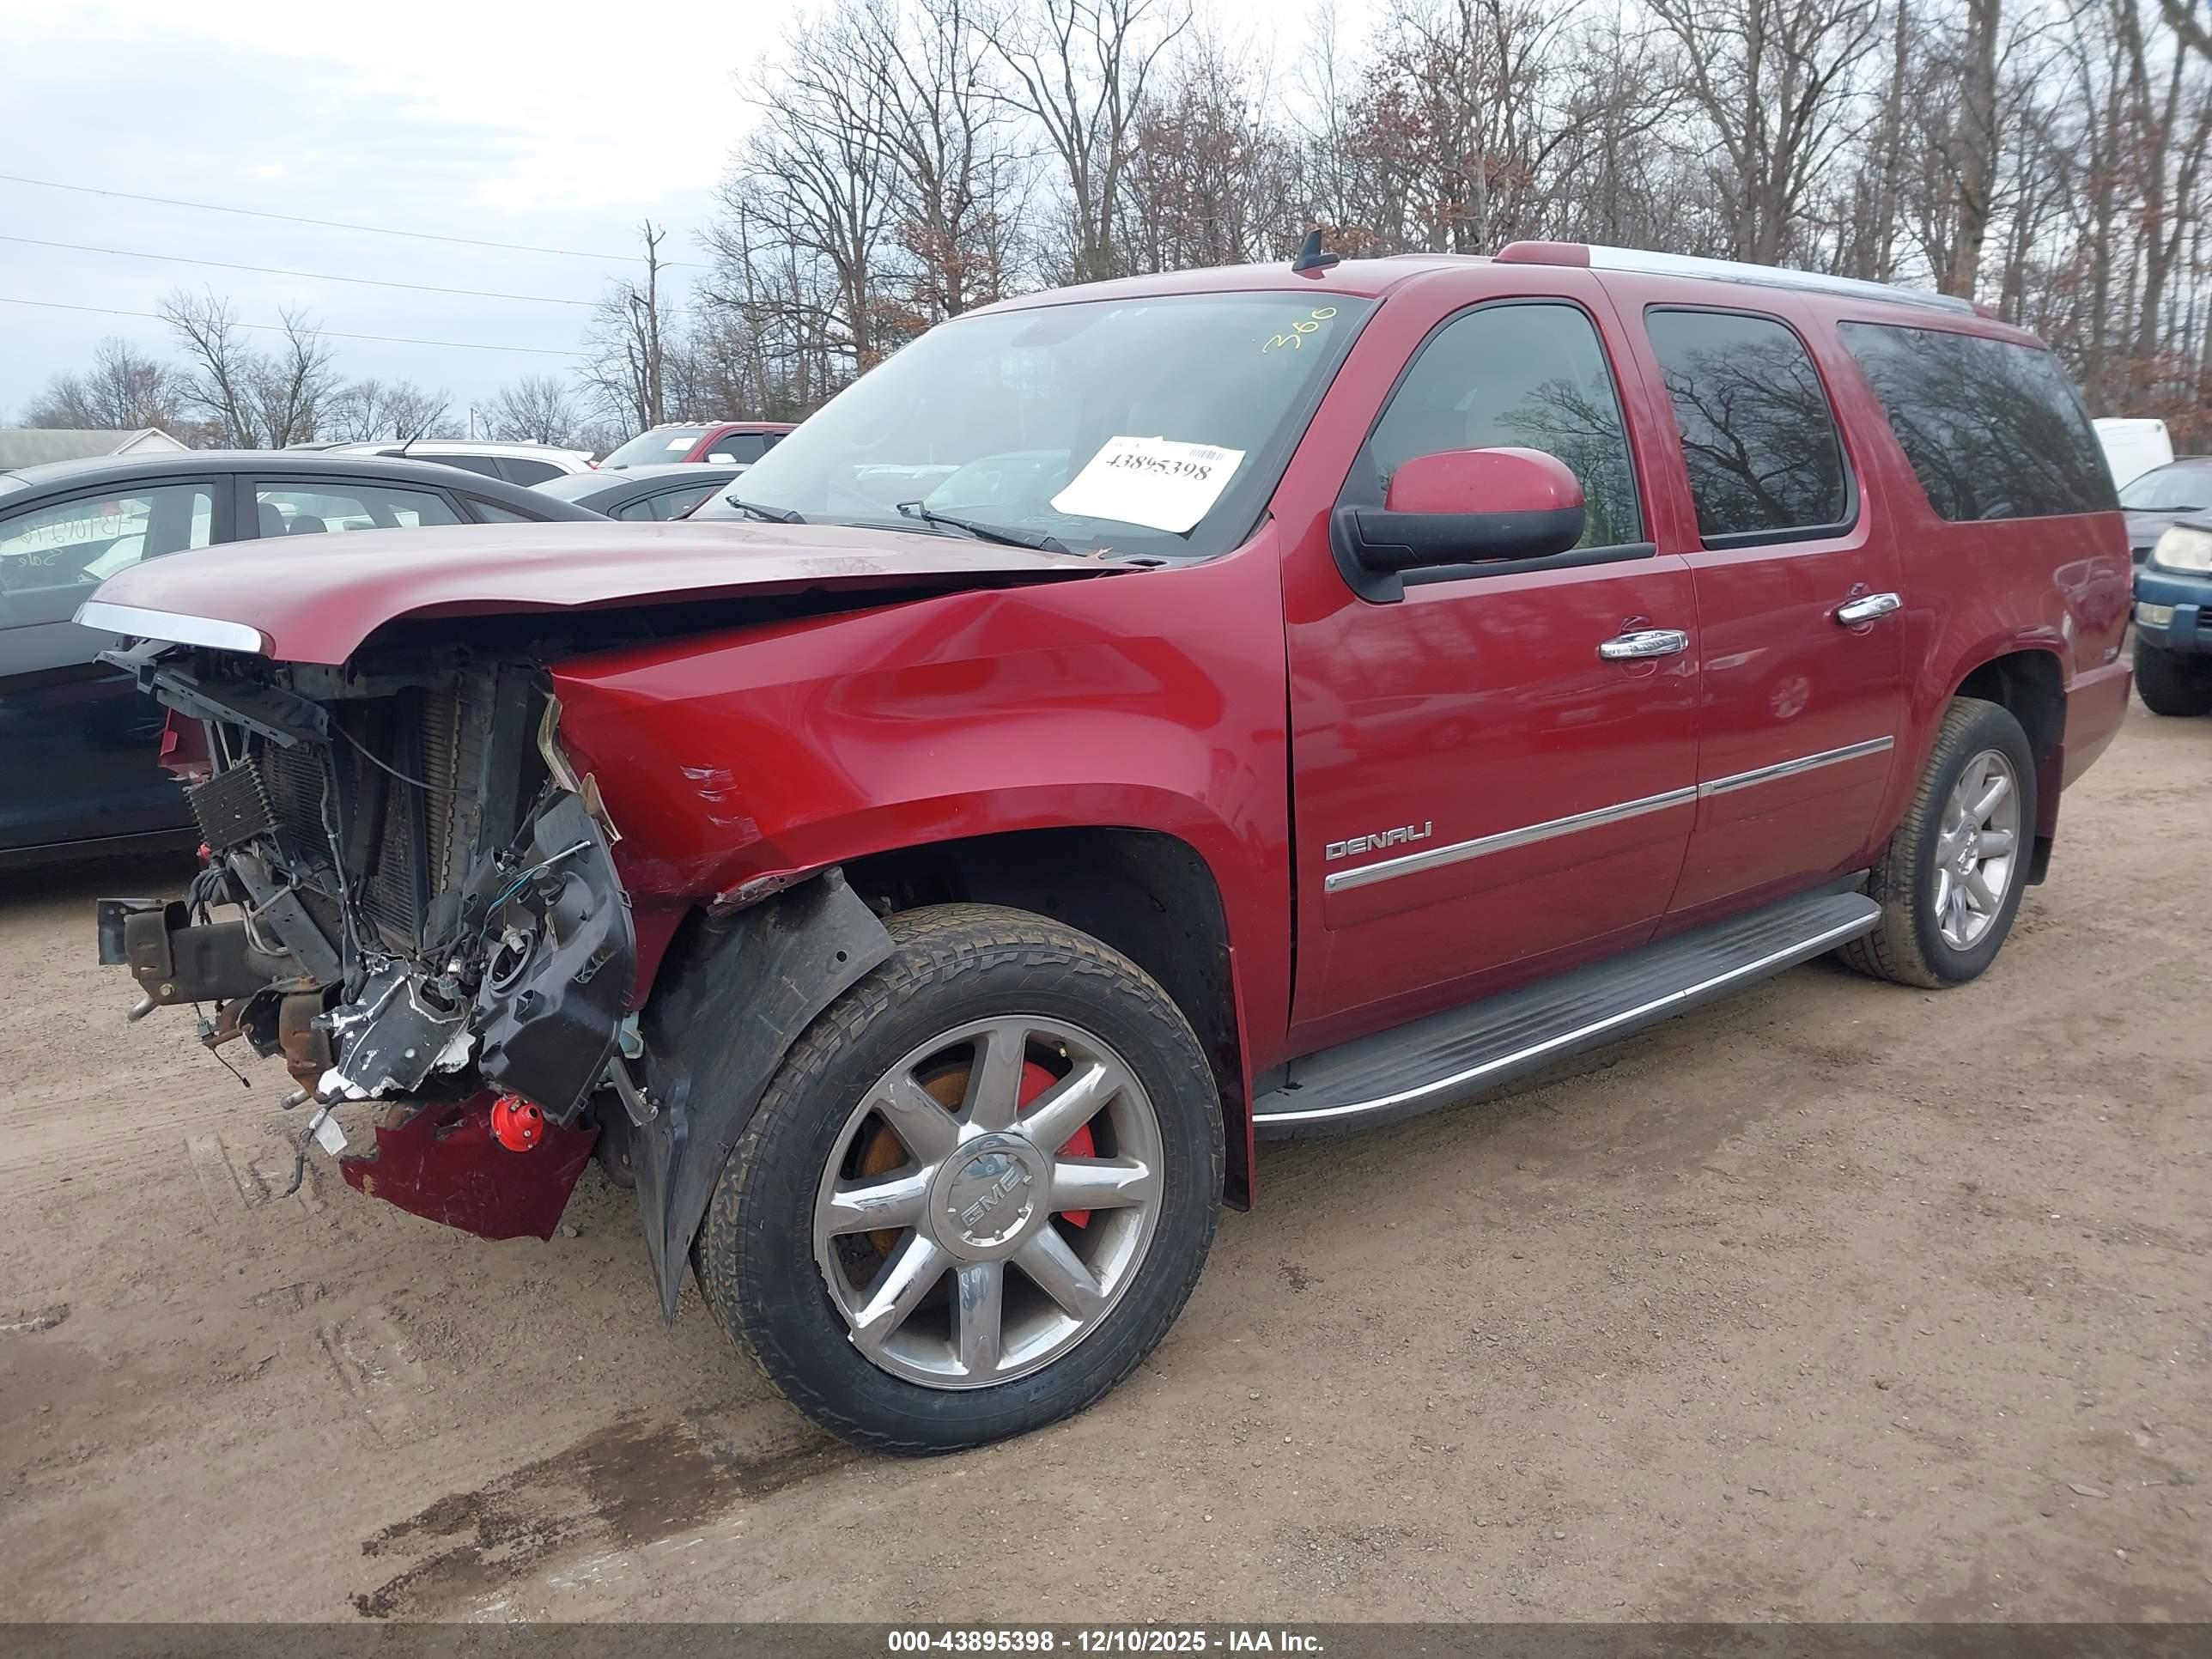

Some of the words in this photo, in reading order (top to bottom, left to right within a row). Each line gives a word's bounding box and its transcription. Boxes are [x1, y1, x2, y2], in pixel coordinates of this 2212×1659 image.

[1106, 453, 1212, 481] 43895398
[1325, 820, 1433, 861] DENALI
[961, 1166, 1021, 1227] GMC
